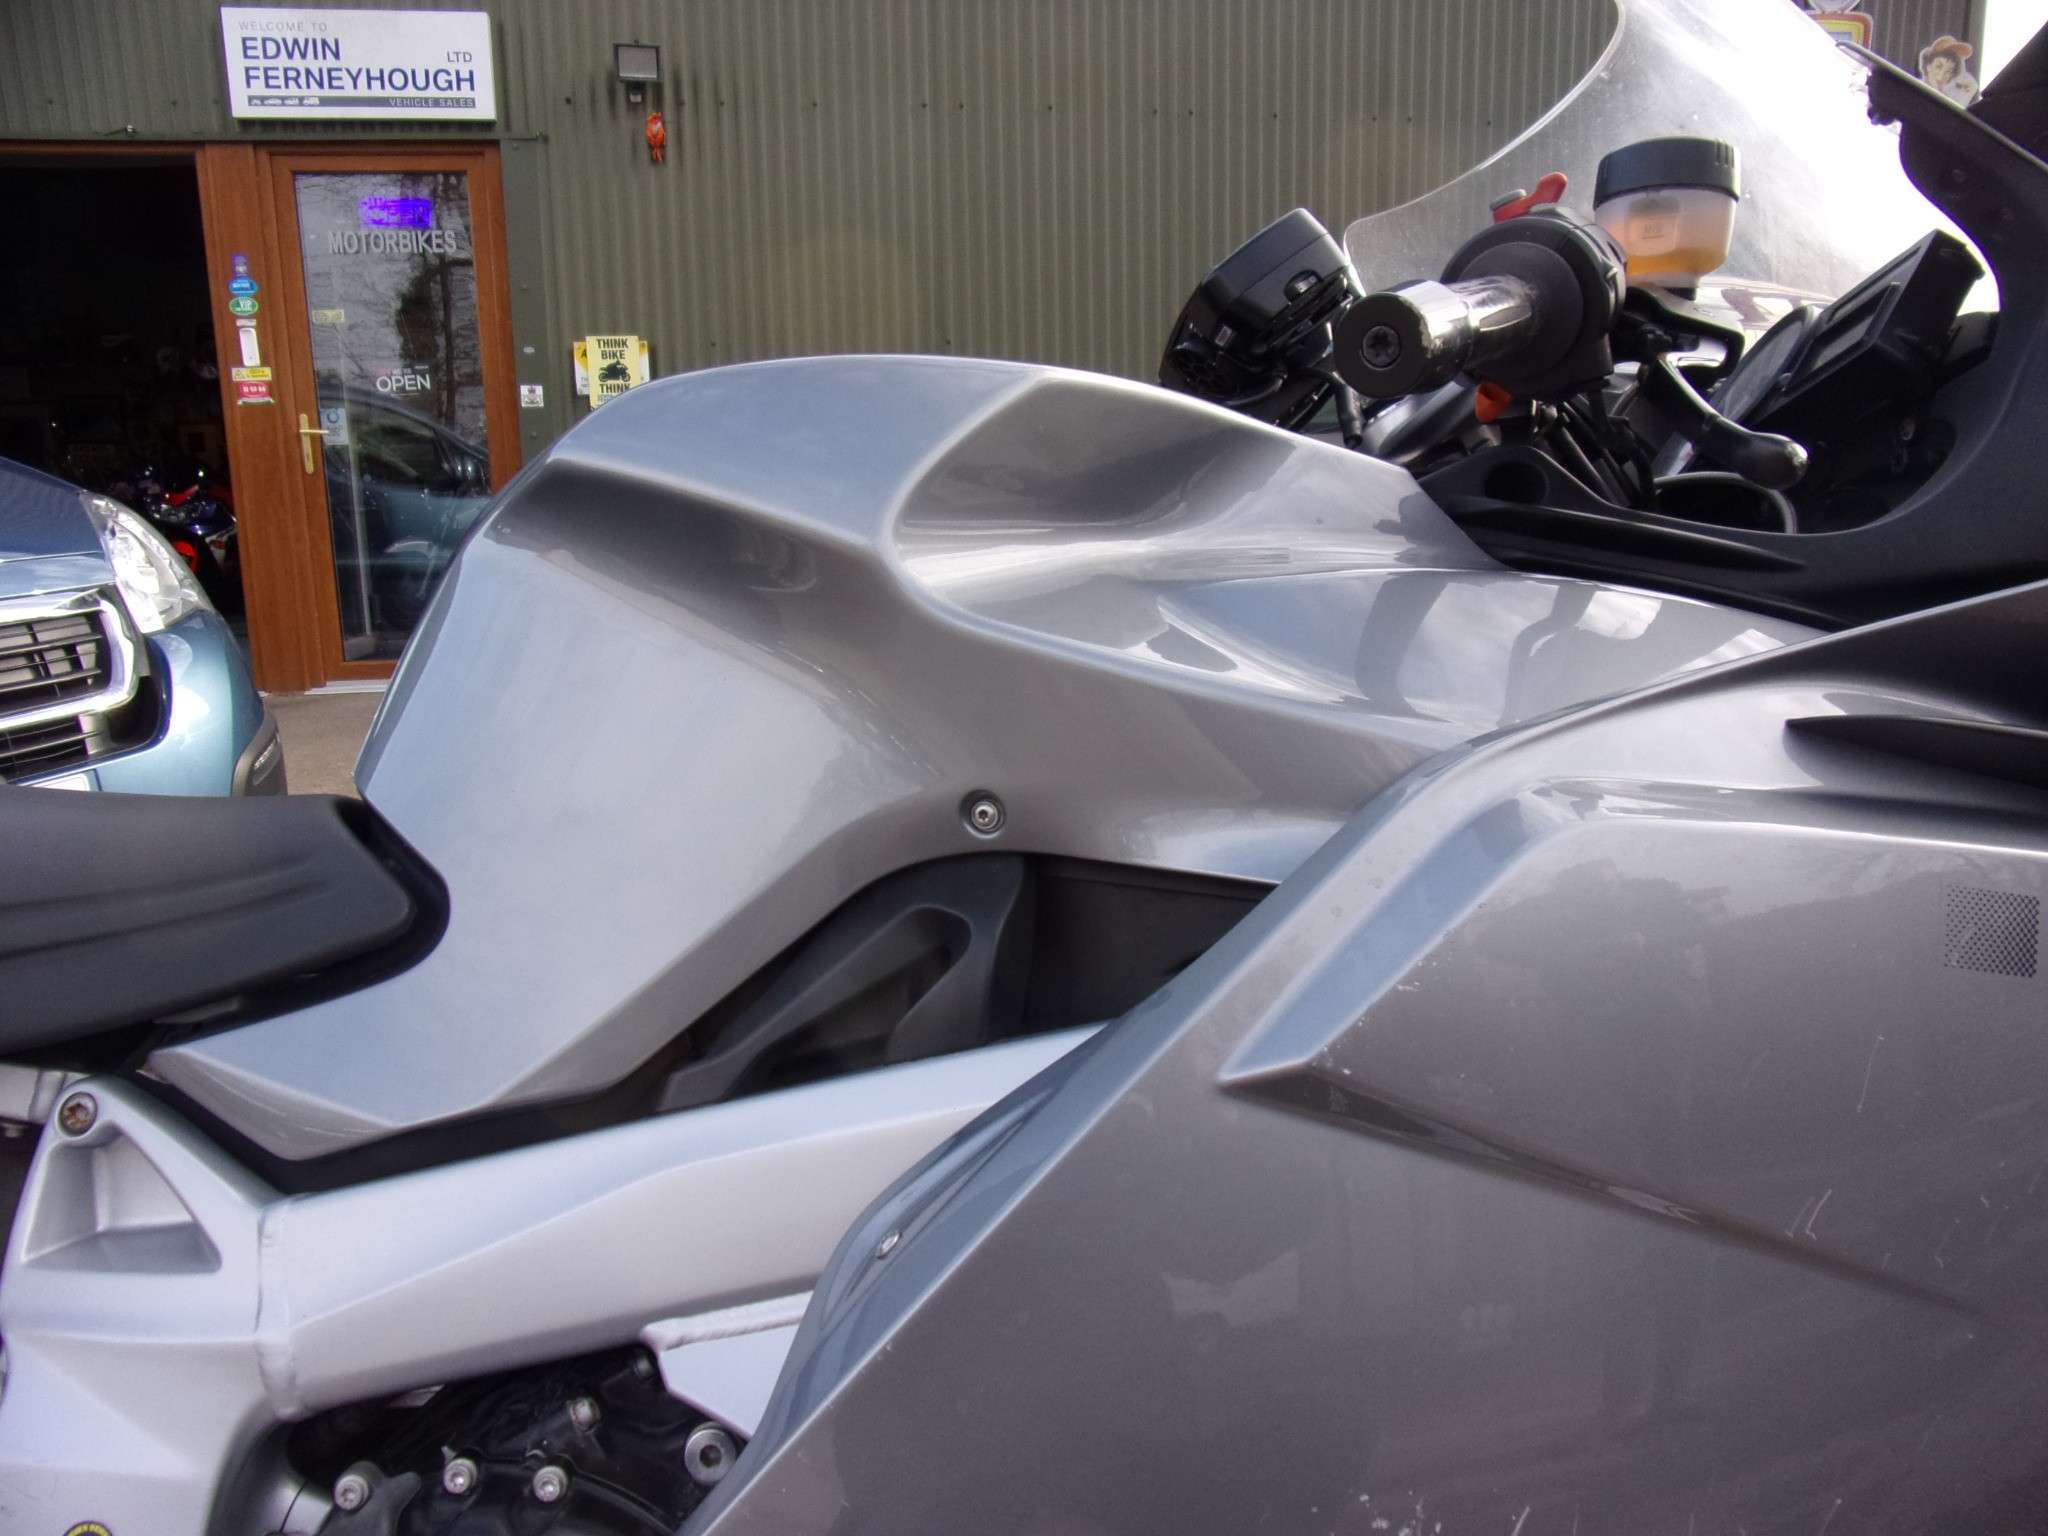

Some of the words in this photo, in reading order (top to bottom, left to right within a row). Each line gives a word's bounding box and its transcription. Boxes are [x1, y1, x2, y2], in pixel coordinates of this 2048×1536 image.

[239, 21, 304, 32] WELCOME
[311, 22, 328, 32] TO
[242, 36, 340, 61] EDWIN
[446, 51, 473, 63] LTD
[246, 66, 475, 91] FERNEYHOUGH
[388, 97, 434, 107] VEHICLE
[439, 97, 474, 107] SALES
[328, 230, 457, 254] MOTORBIKES
[597, 338, 629, 349] THINK
[601, 350, 626, 360] BIKE
[376, 374, 431, 392] OPEN
